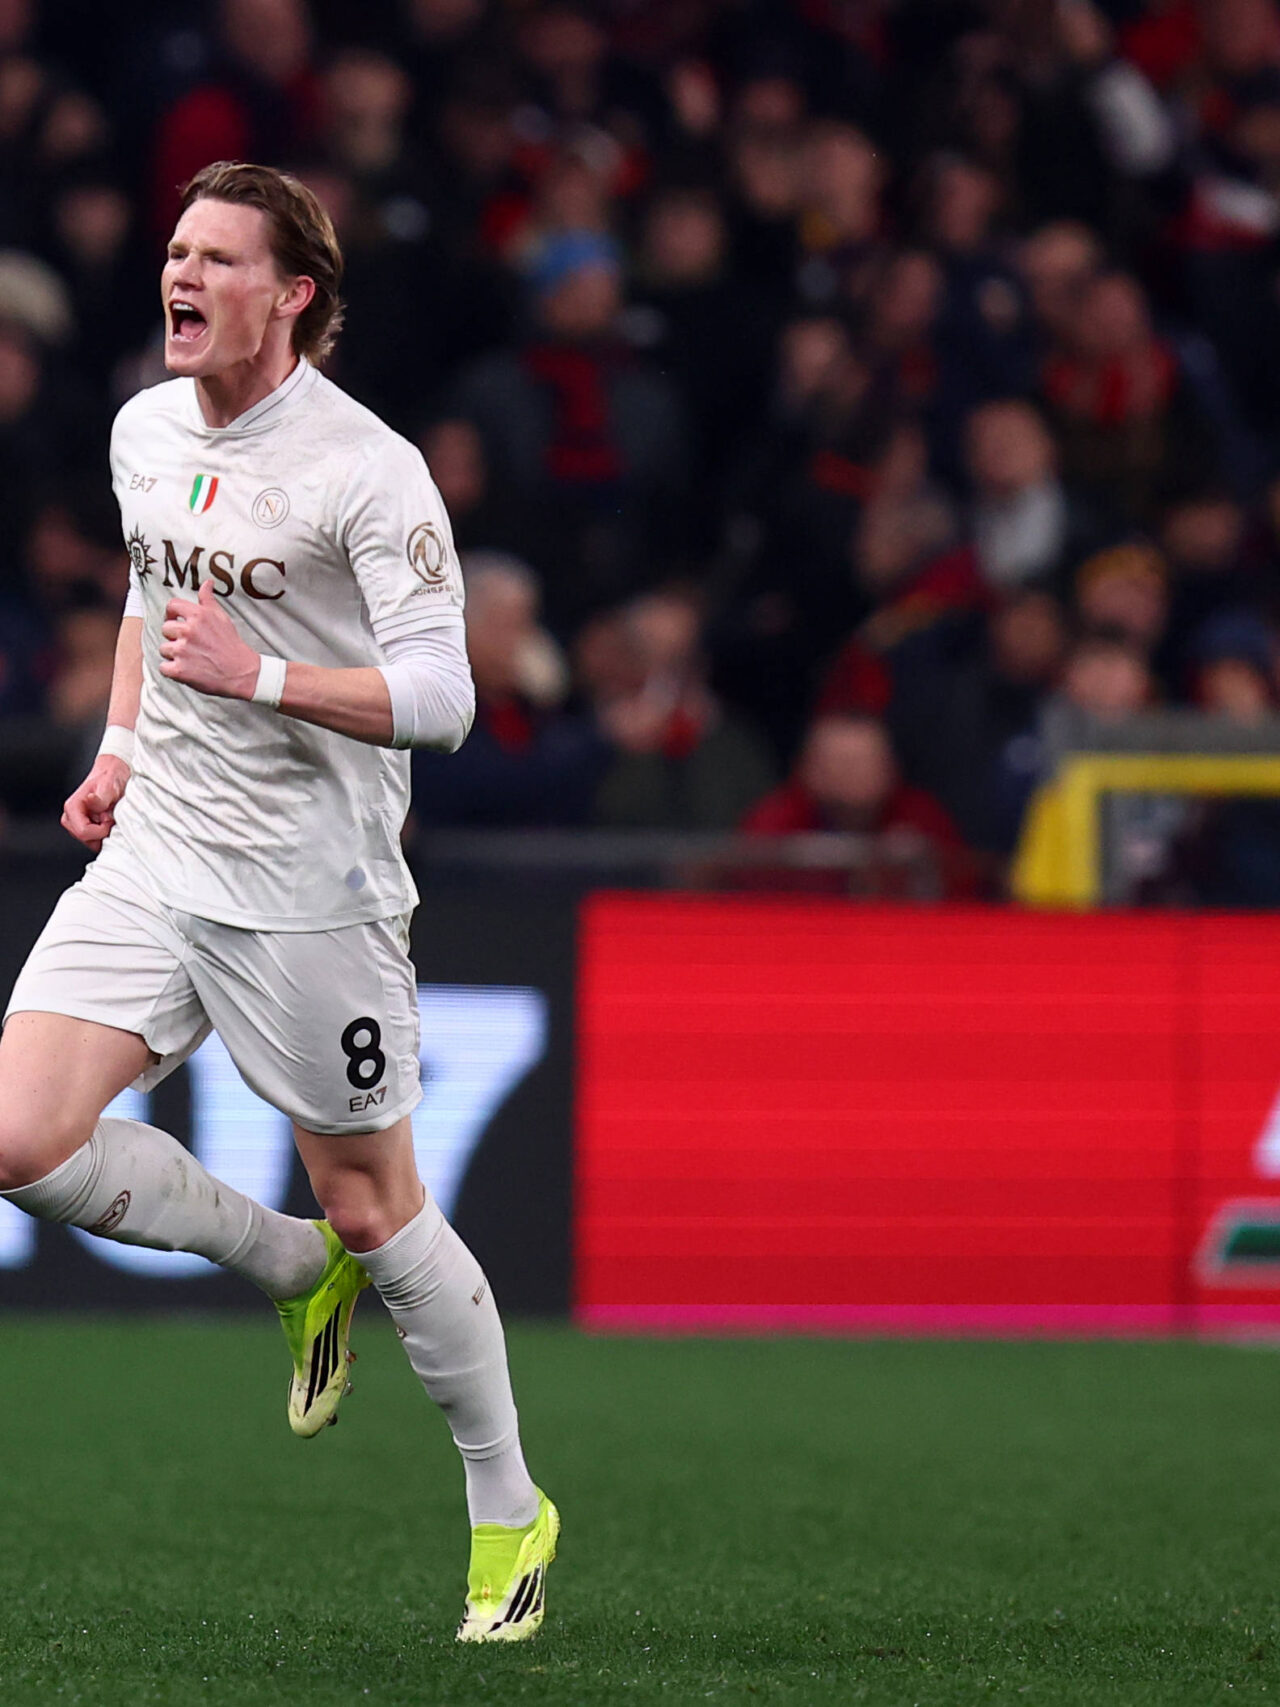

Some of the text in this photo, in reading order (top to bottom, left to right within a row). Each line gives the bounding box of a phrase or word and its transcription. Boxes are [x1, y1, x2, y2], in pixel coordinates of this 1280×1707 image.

[129, 473, 159, 493] EA7
[161, 539, 286, 600] MSC
[340, 1016, 386, 1090] 8
[349, 1085, 388, 1113] EA7
